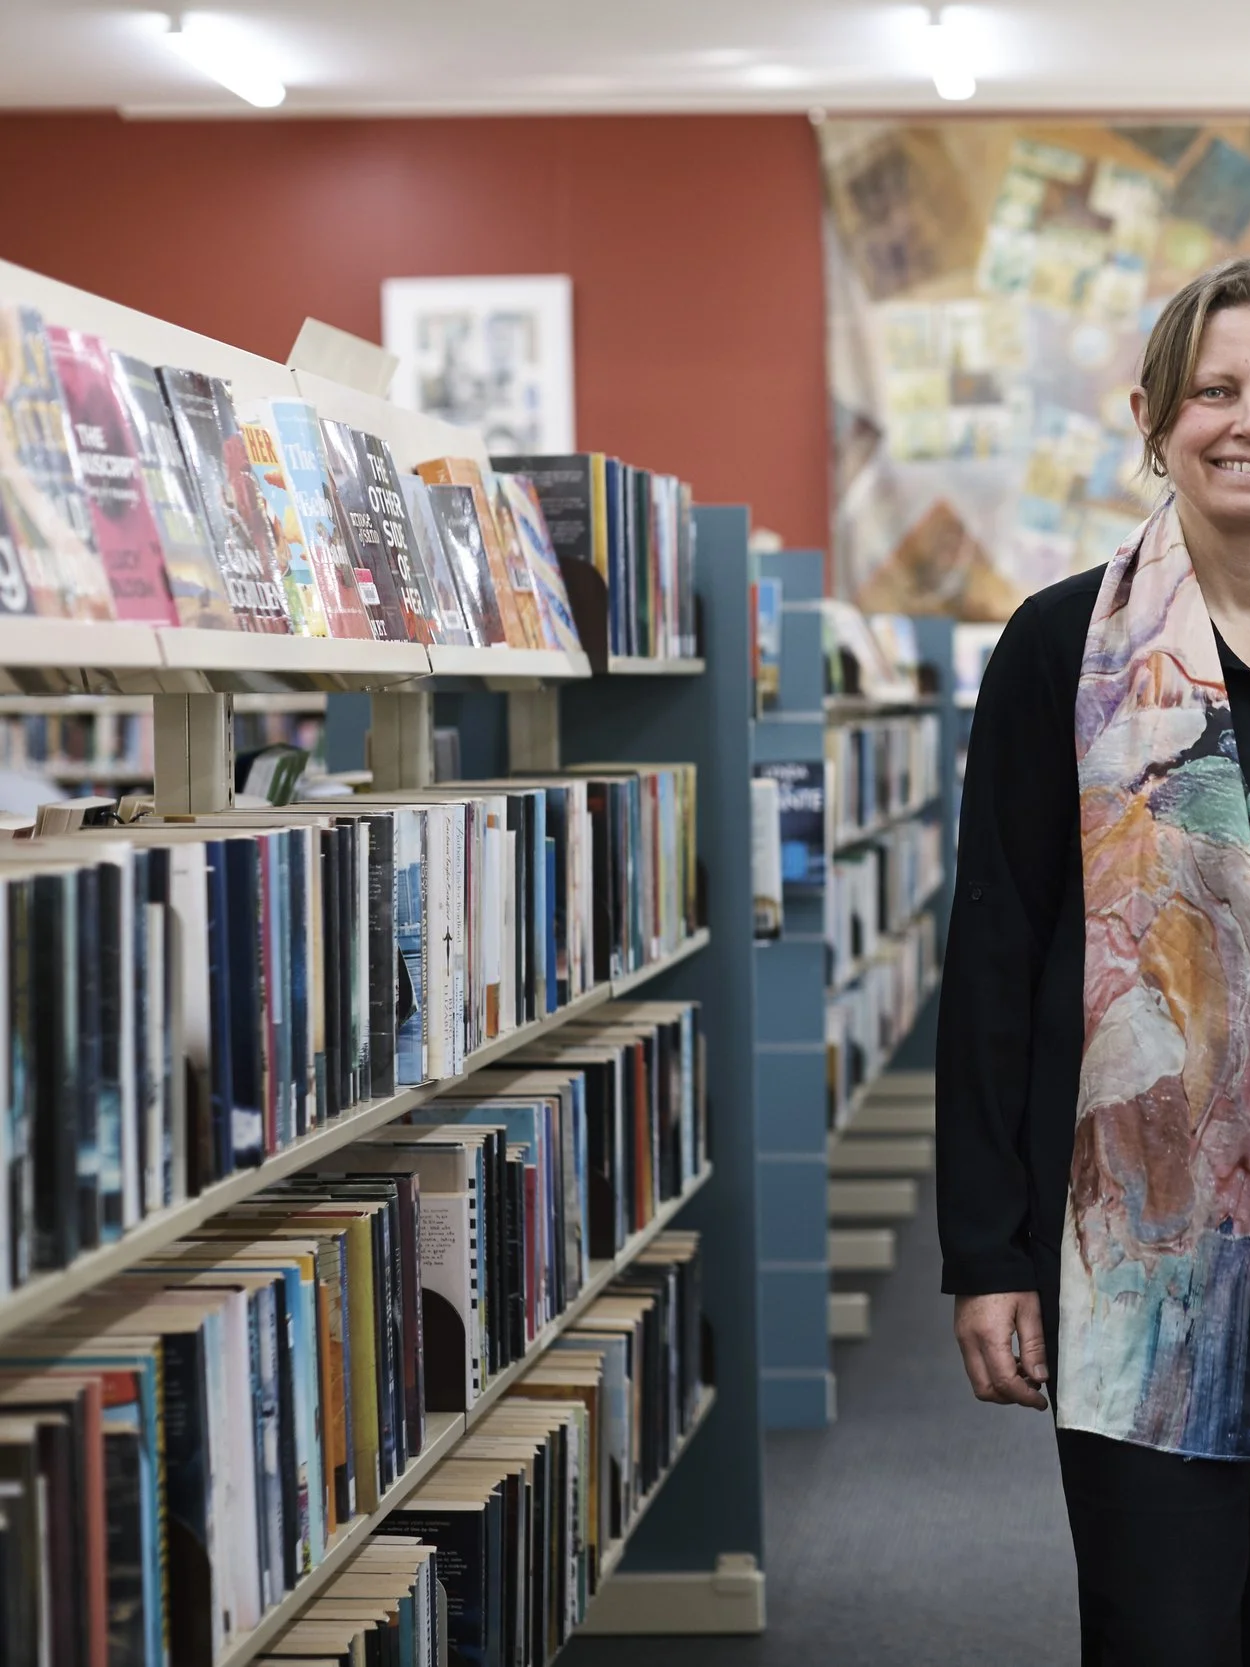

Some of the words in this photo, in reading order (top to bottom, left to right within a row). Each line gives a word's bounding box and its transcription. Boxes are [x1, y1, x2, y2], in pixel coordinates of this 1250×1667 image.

[366, 452, 389, 484] THE
[368, 485, 405, 518] OTHER
[382, 519, 408, 550] SIDE
[397, 553, 411, 581] OF
[401, 587, 424, 615] HER
